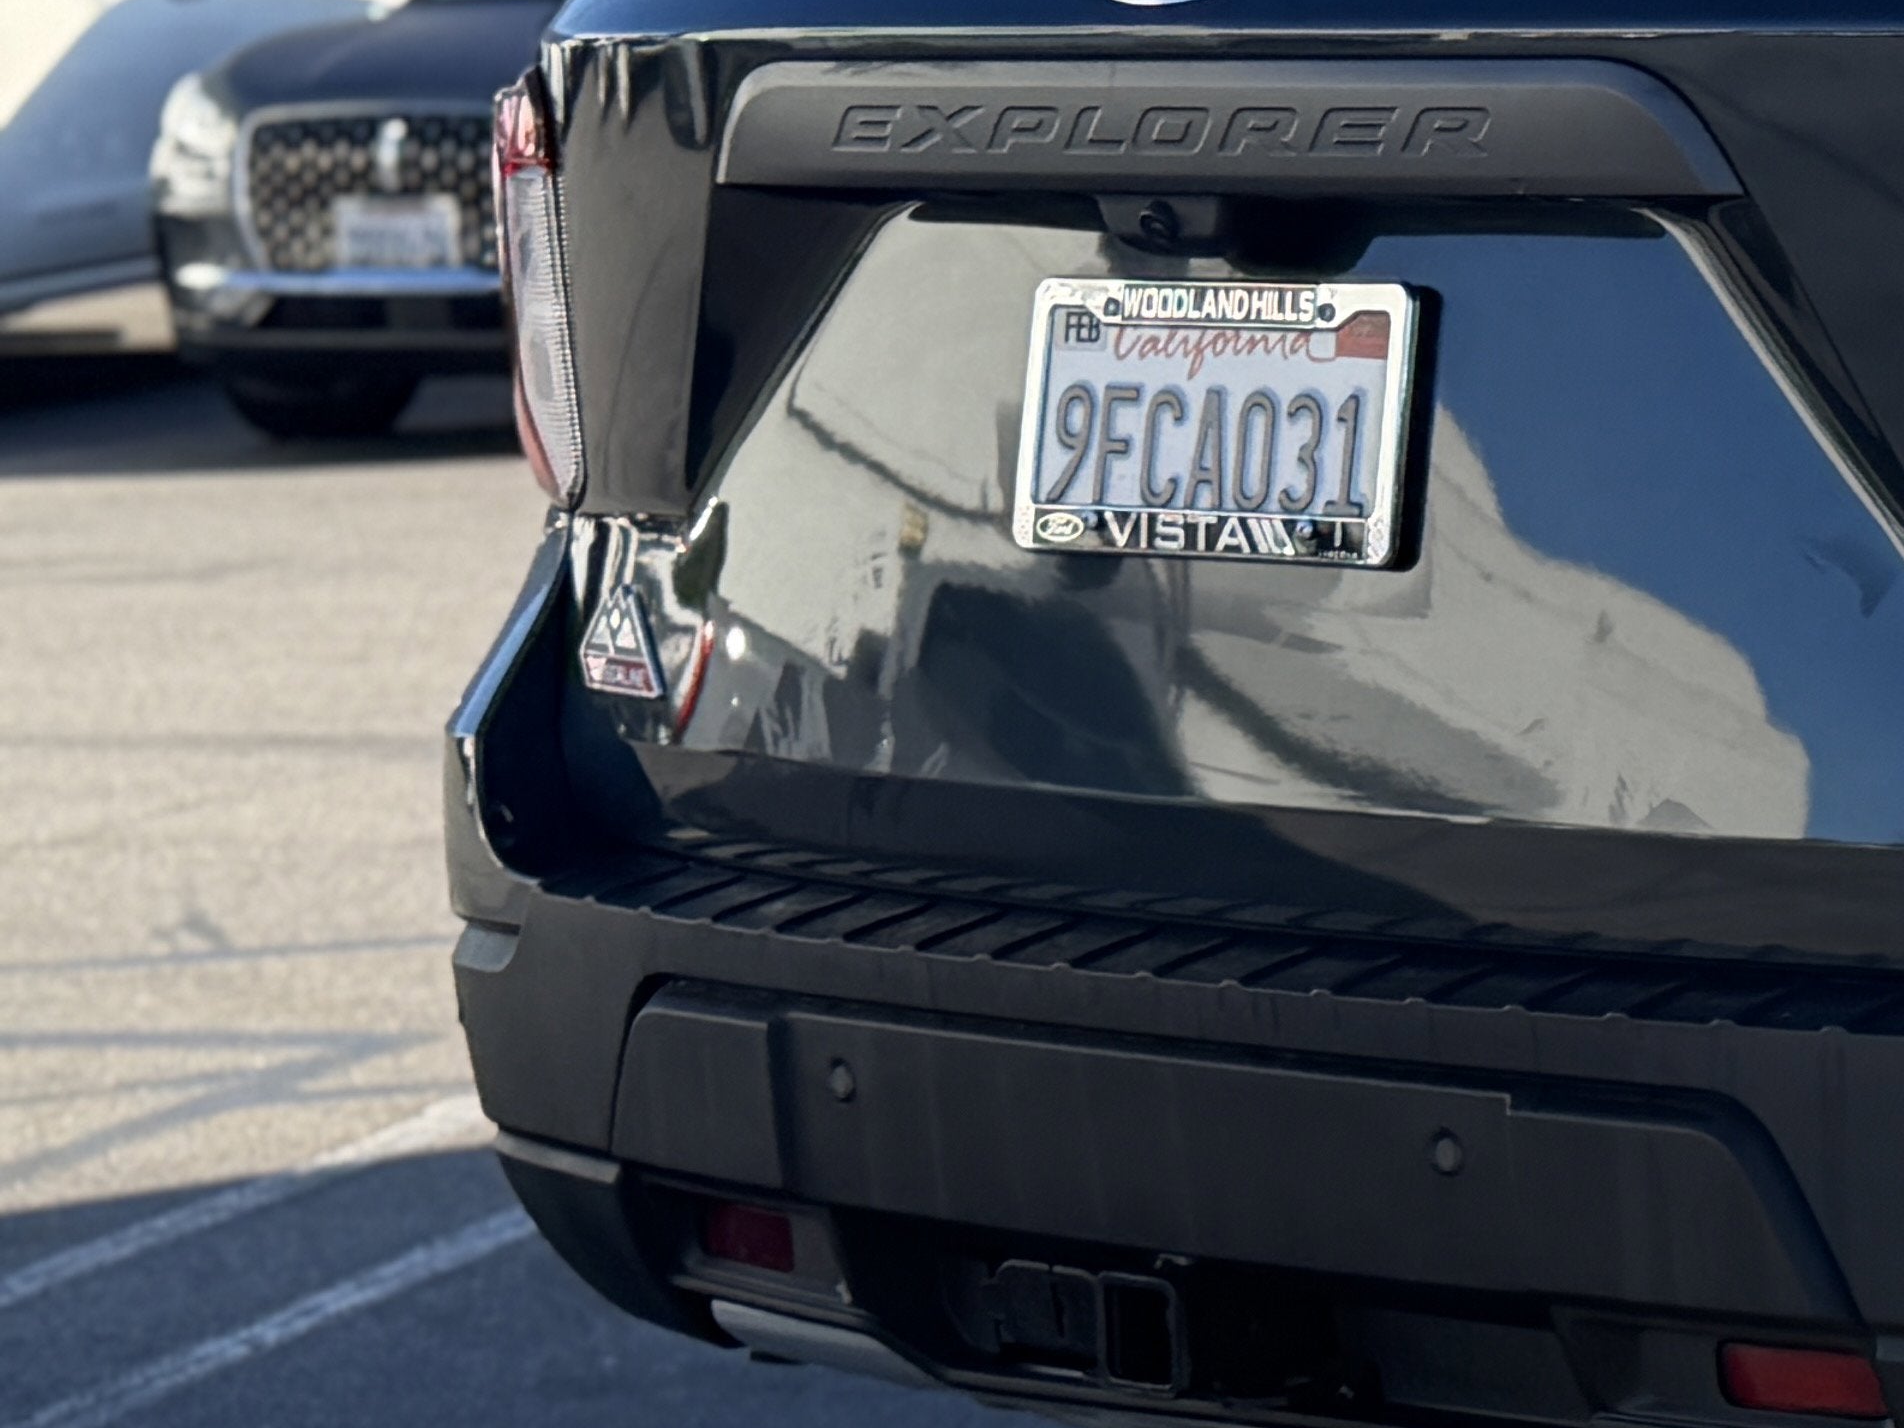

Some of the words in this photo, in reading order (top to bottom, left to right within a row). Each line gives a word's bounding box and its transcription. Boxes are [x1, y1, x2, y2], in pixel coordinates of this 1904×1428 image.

[831, 105, 1489, 156] EXPLORER
[1064, 311, 1101, 343] FEB
[1123, 287, 1250, 320] WOODLAND
[1250, 290, 1315, 323] HILLS
[1044, 383, 1364, 517] 9FCA031
[1103, 510, 1251, 554] VISTA
